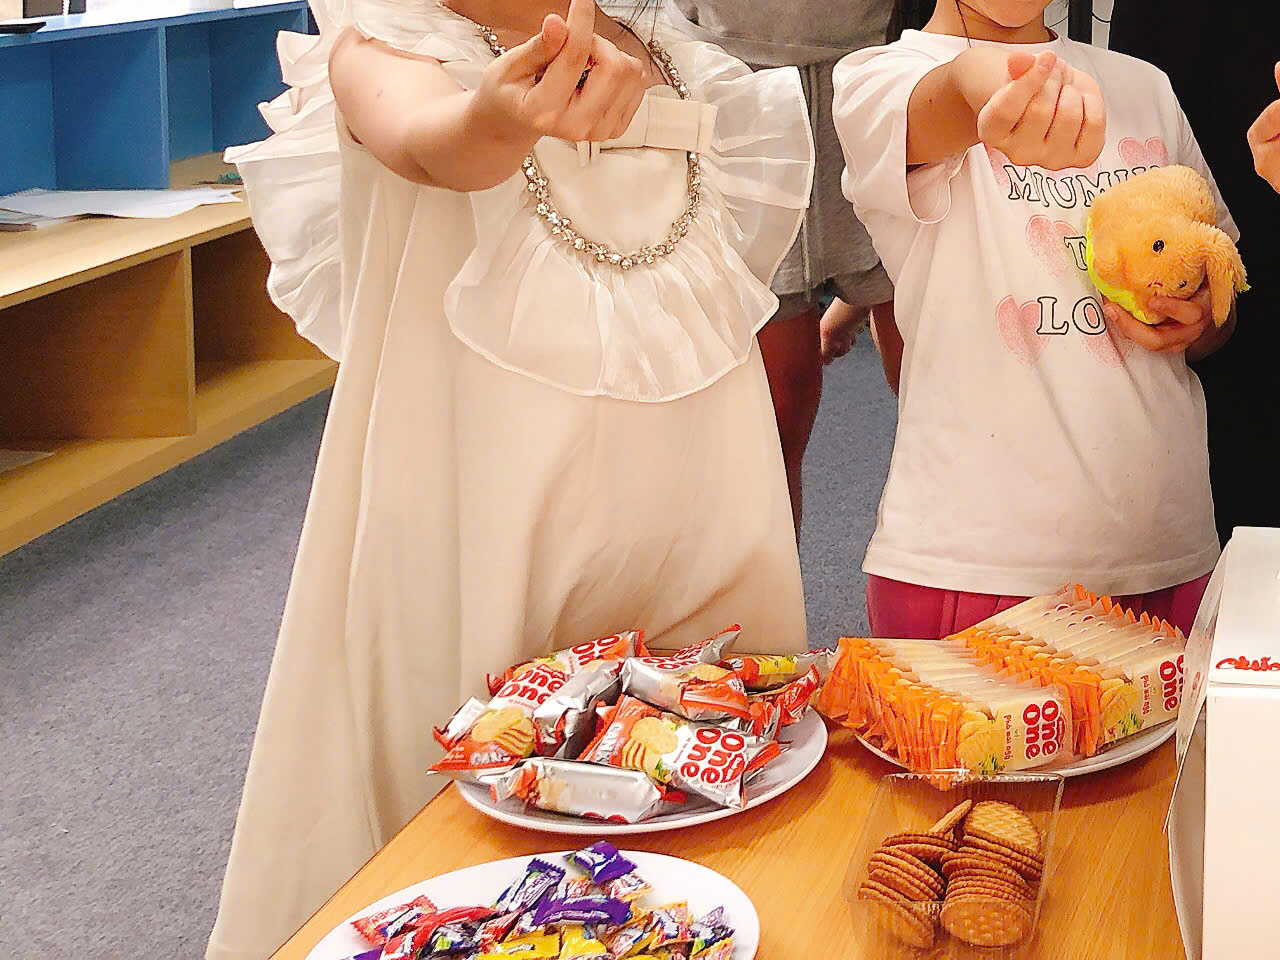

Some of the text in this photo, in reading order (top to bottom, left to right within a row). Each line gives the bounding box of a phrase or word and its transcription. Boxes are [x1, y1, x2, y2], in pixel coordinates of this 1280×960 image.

[1036, 295, 1107, 336] LO
[1160, 660, 1179, 712] One
[680, 727, 722, 778] One
[1022, 703, 1041, 760] One
[1041, 699, 1059, 757] One
[700, 733, 745, 784] One
